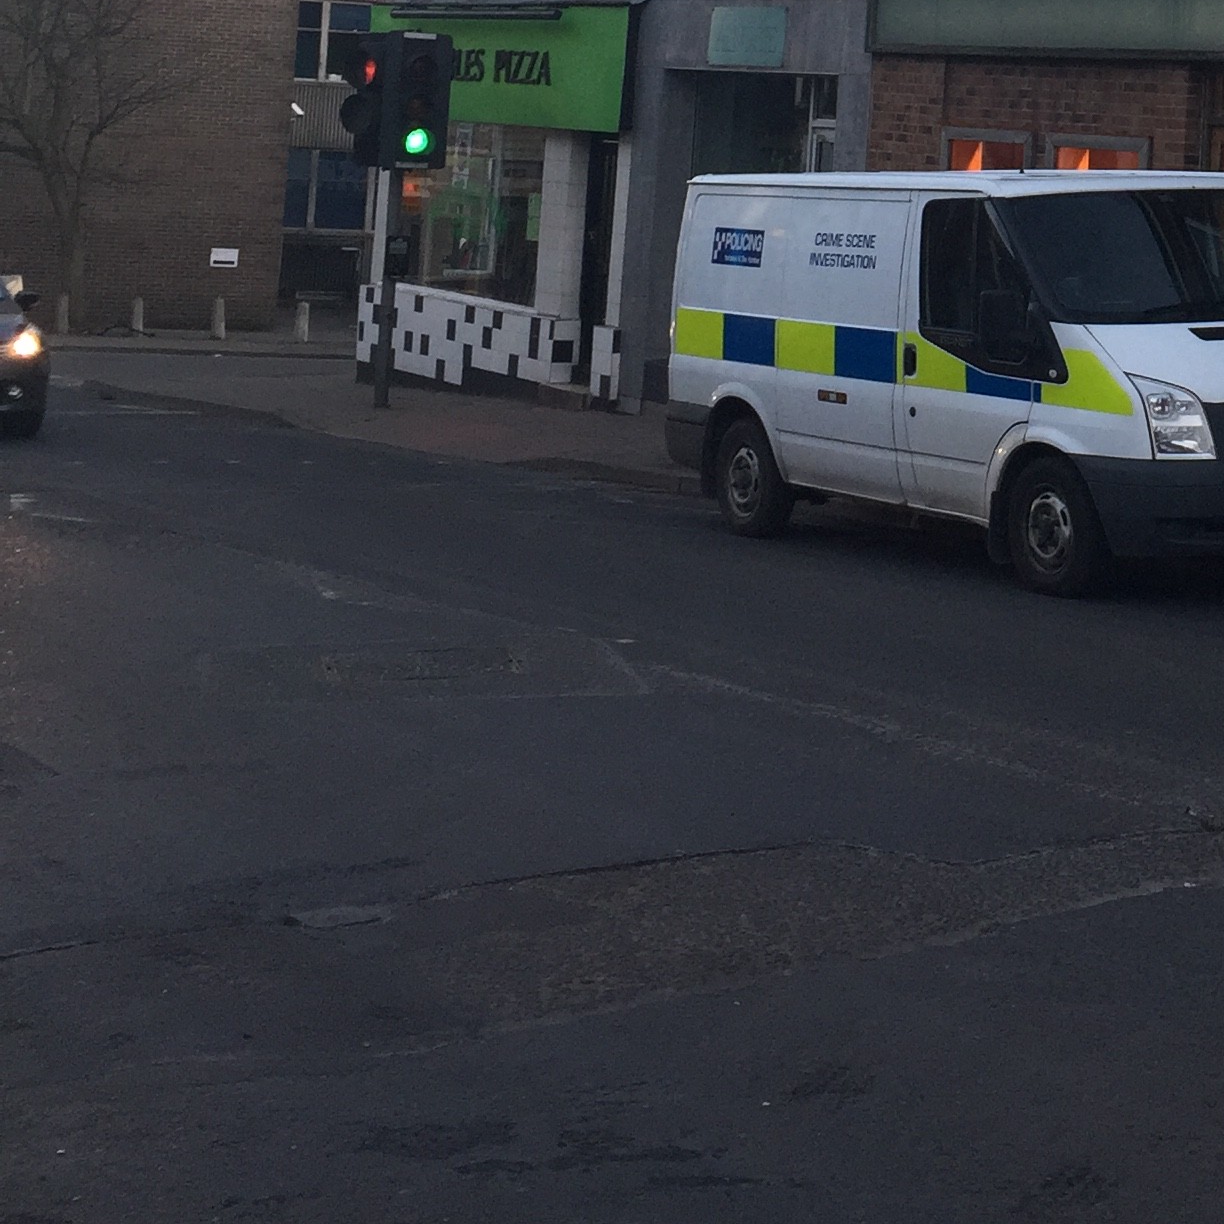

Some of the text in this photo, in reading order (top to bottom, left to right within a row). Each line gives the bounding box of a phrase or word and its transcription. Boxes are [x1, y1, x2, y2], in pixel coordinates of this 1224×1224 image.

[493, 49, 553, 87] PIZZA
[724, 232, 763, 252] POLICING
[814, 232, 877, 249] CRIME SCENE
[808, 252, 878, 270] INVESTIGATION
